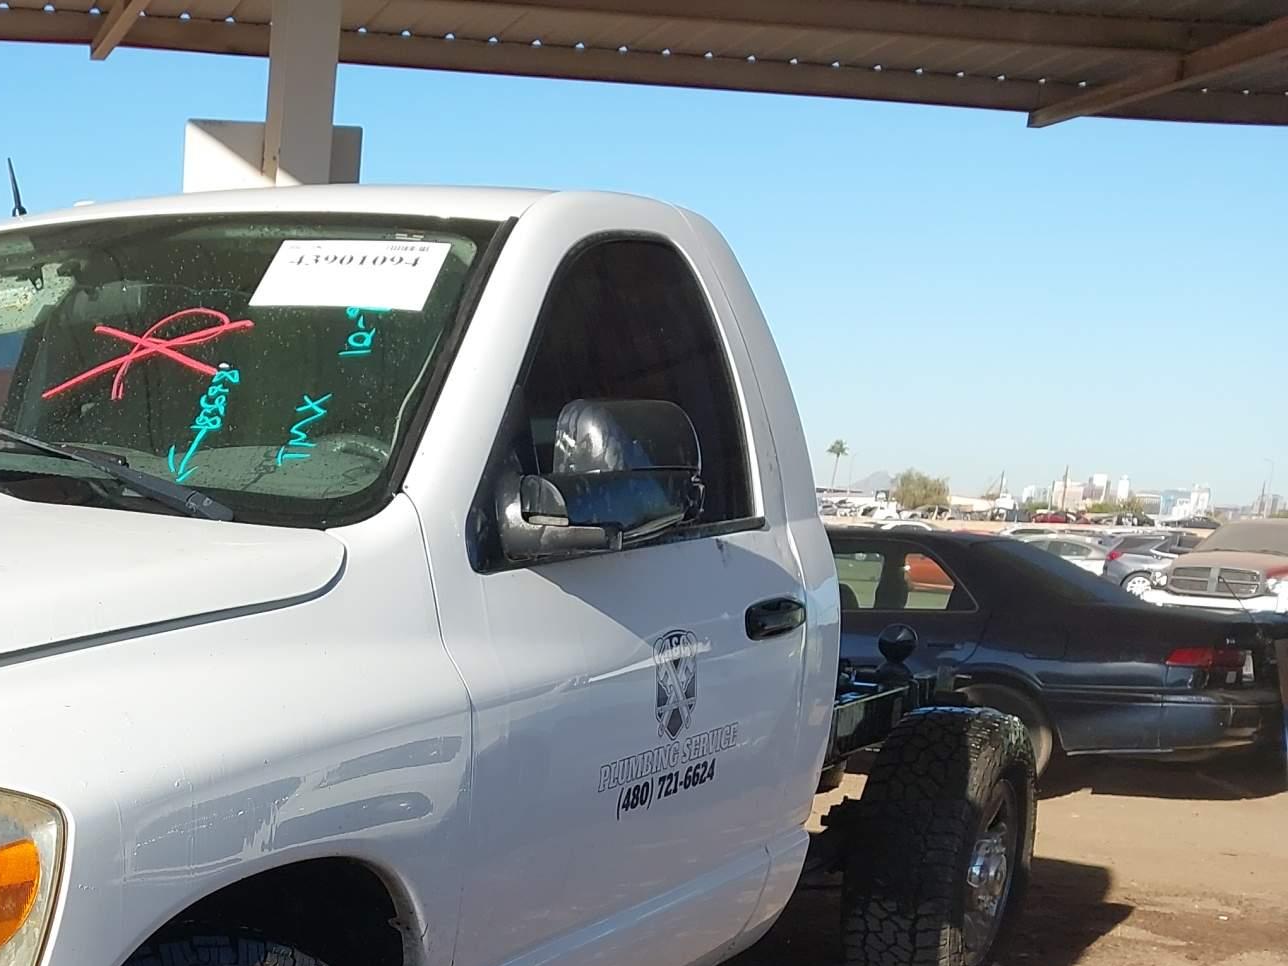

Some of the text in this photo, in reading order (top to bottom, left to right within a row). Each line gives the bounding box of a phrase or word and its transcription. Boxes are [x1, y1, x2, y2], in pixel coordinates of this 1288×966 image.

[598, 722, 740, 793] PLUMBING SERVICE
[616, 757, 717, 821] (480) 721-6624
